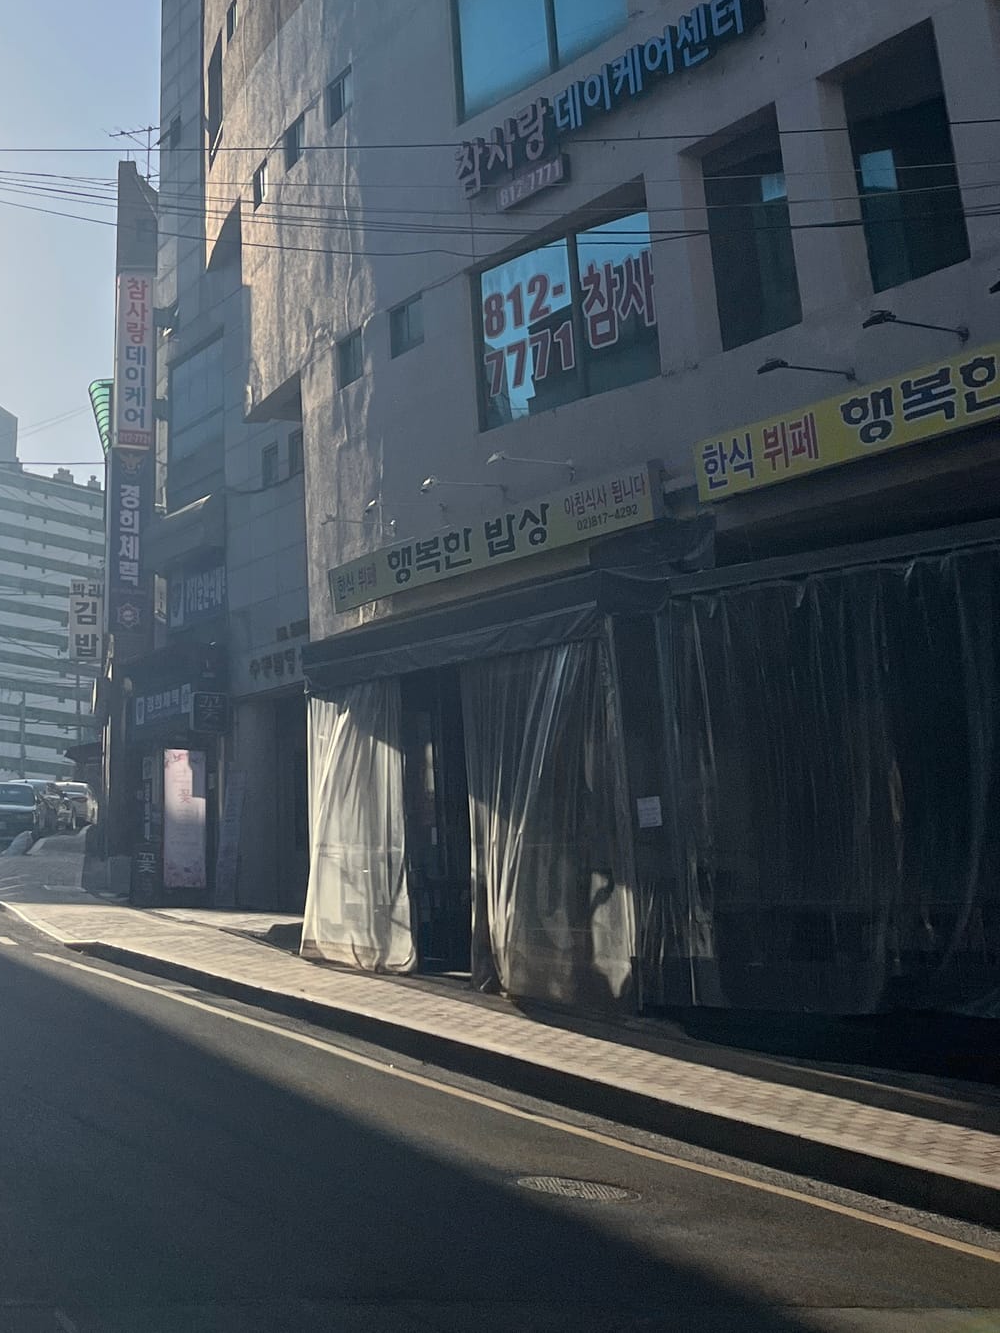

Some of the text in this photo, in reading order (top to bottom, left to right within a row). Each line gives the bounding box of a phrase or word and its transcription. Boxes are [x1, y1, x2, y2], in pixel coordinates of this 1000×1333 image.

[484, 272, 566, 339] 812-
[581, 247, 658, 350] 참사
[123, 277, 149, 430] 참사랑데이케어
[484, 319, 576, 398] 7771
[701, 431, 756, 490] 한식
[762, 411, 820, 471] 뷔페
[118, 483, 141, 587] 경희체력
[563, 483, 608, 517] 아침식사
[336, 575, 355, 600] 한식
[386, 527, 473, 585] 행복한
[484, 501, 550, 558] 밥상
[73, 601, 100, 657] 김밥
